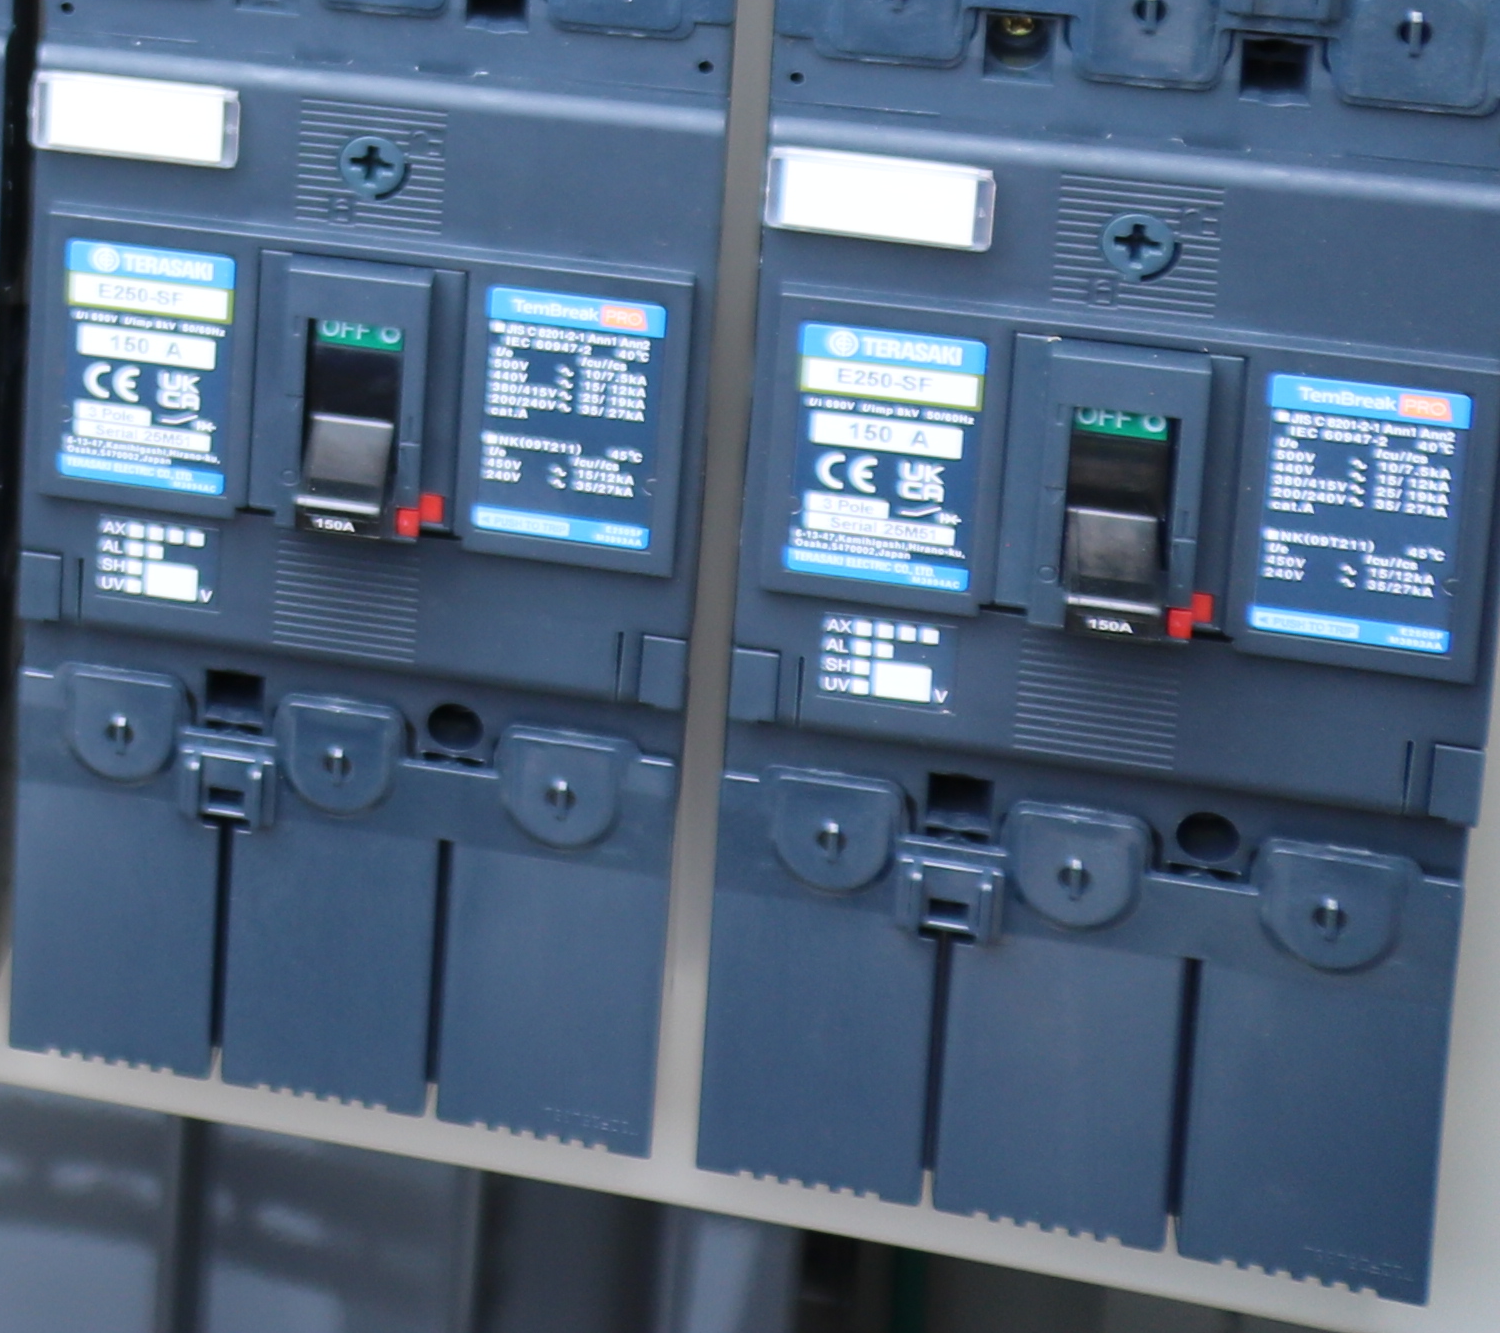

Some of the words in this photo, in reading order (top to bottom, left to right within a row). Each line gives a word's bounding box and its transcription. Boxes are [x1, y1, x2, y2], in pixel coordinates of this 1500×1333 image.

[121, 252, 214, 282] TERASAKI
[99, 284, 184, 308] E250-SF
[512, 297, 600, 322] TemBreak
[604, 310, 643, 327] PRO
[111, 334, 149, 355] 150
[165, 342, 183, 360] A
[861, 336, 963, 367] TERASAKI
[836, 366, 933, 394] E250-SF
[1297, 385, 1398, 412] TemBreak
[1402, 399, 1448, 417] PRO
[848, 421, 893, 444] 150
[910, 429, 930, 449] A
[837, 498, 875, 515] Pole
[102, 521, 126, 536] AX
[314, 517, 356, 533] 150A
[829, 515, 877, 533] Serial
[102, 539, 124, 554] AL
[102, 557, 126, 572] SH
[101, 575, 125, 591] UV
[200, 588, 213, 603] V
[826, 618, 853, 634] AX
[1088, 617, 1134, 634] 150A
[825, 637, 849, 654] AL
[825, 656, 852, 673] SH
[824, 676, 851, 692] UV
[934, 688, 949, 704] V
